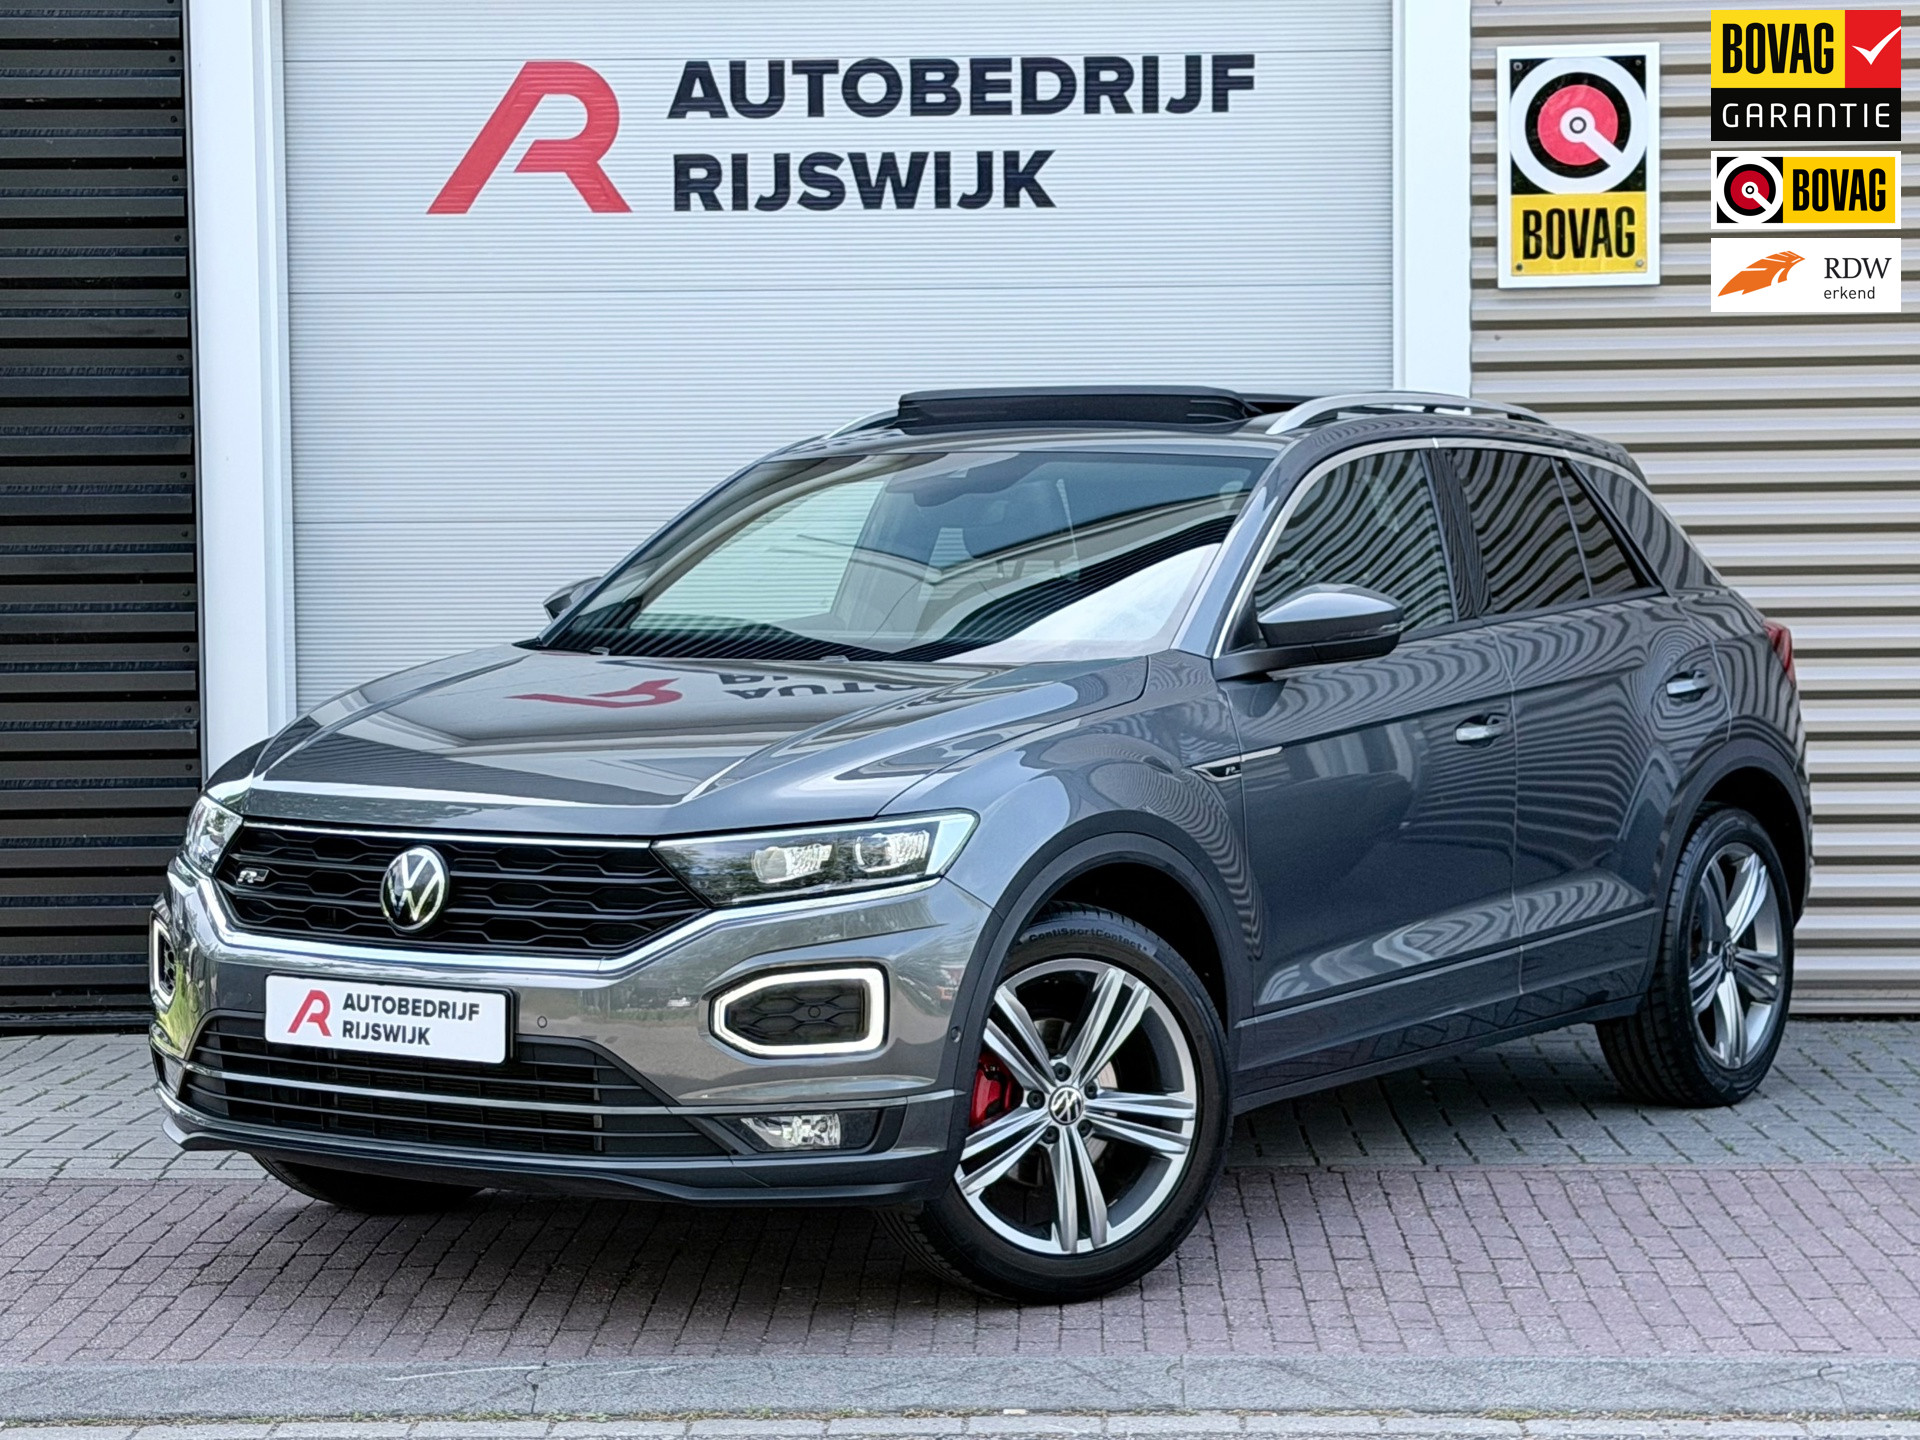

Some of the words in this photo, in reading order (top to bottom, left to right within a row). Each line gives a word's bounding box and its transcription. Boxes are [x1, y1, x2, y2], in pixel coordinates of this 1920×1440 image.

[667, 54, 1255, 119] AUTOBEDRIJF
[673, 150, 1056, 212] RIJSWIJK
[1522, 206, 1635, 260] BOVAG
[342, 992, 480, 1021] AUTOBEDRIJF
[342, 1020, 431, 1045] RIJSWIJK
